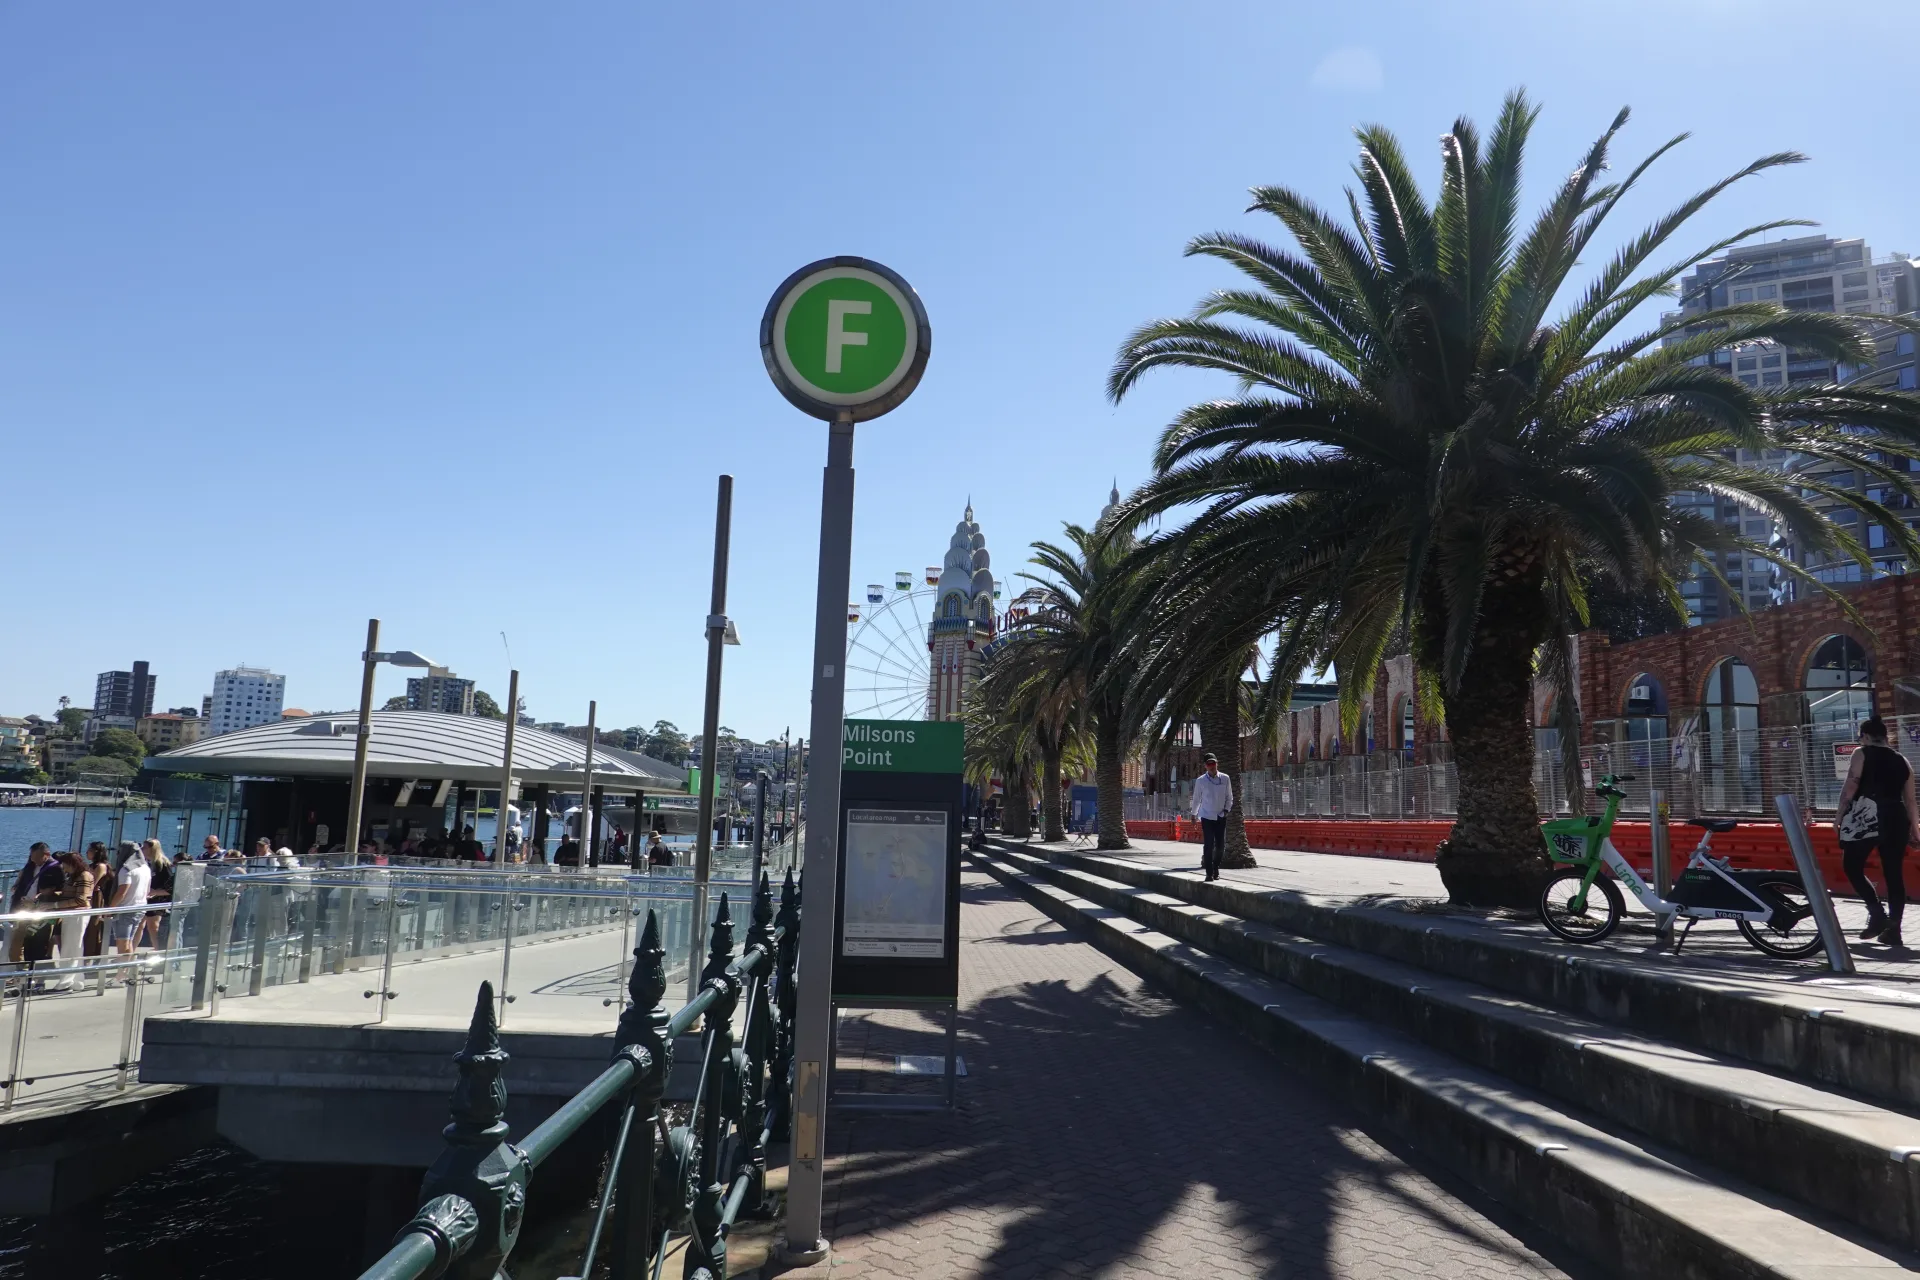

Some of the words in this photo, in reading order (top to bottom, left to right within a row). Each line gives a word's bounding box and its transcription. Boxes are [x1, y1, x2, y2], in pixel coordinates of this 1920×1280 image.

[825, 299, 872, 373] F
[843, 724, 915, 743] Milsons
[842, 747, 892, 765] Point
[882, 815, 897, 823] map
[1614, 862, 1643, 896] Lime
